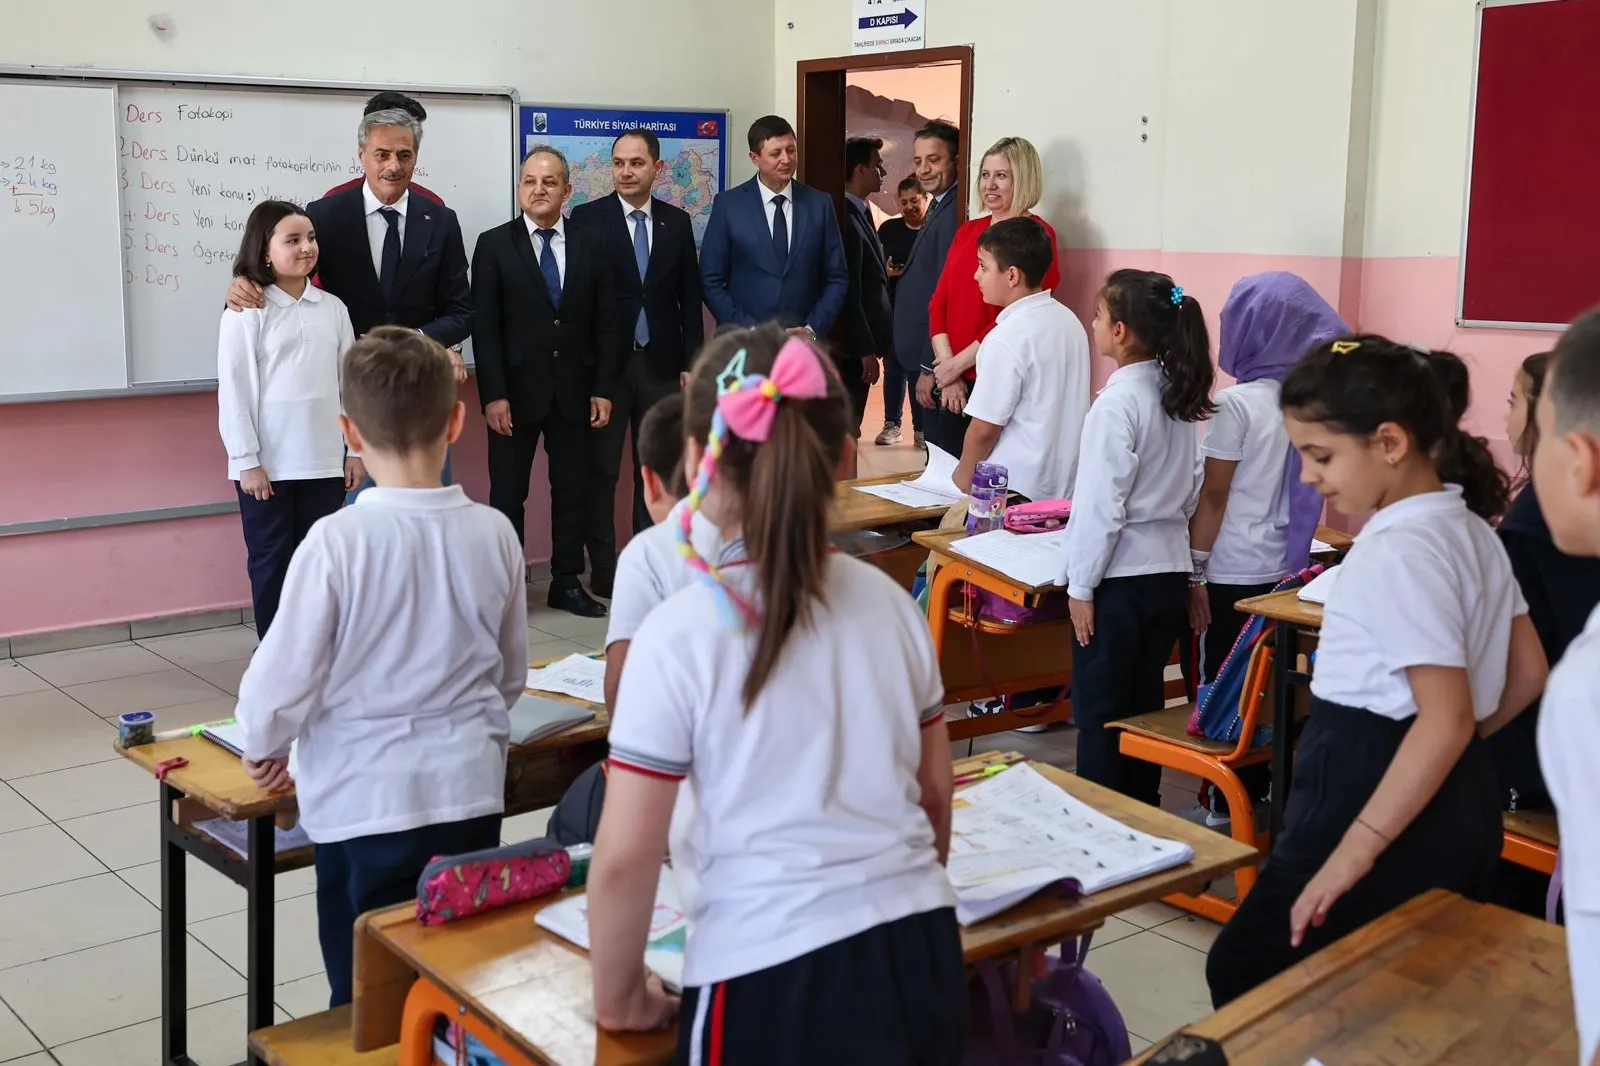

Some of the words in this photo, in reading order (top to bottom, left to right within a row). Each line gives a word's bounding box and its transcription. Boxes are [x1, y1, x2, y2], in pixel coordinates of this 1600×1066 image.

[869, 18, 875, 27] D
[876, 15, 899, 26] KAPISI
[126, 103, 162, 123] Ders
[176, 104, 233, 121] Fotokopi
[573, 118, 610, 130] TÜRKİYE
[611, 119, 638, 131] SİYASİ
[640, 121, 677, 132] HARİTASI
[131, 140, 168, 161] Ders
[229, 153, 256, 166] mat
[40, 158, 57, 175] kg
[42, 177, 58, 196] kg
[140, 170, 176, 194] Ders
[144, 201, 180, 226] Ders
[144, 232, 179, 257] Ders
